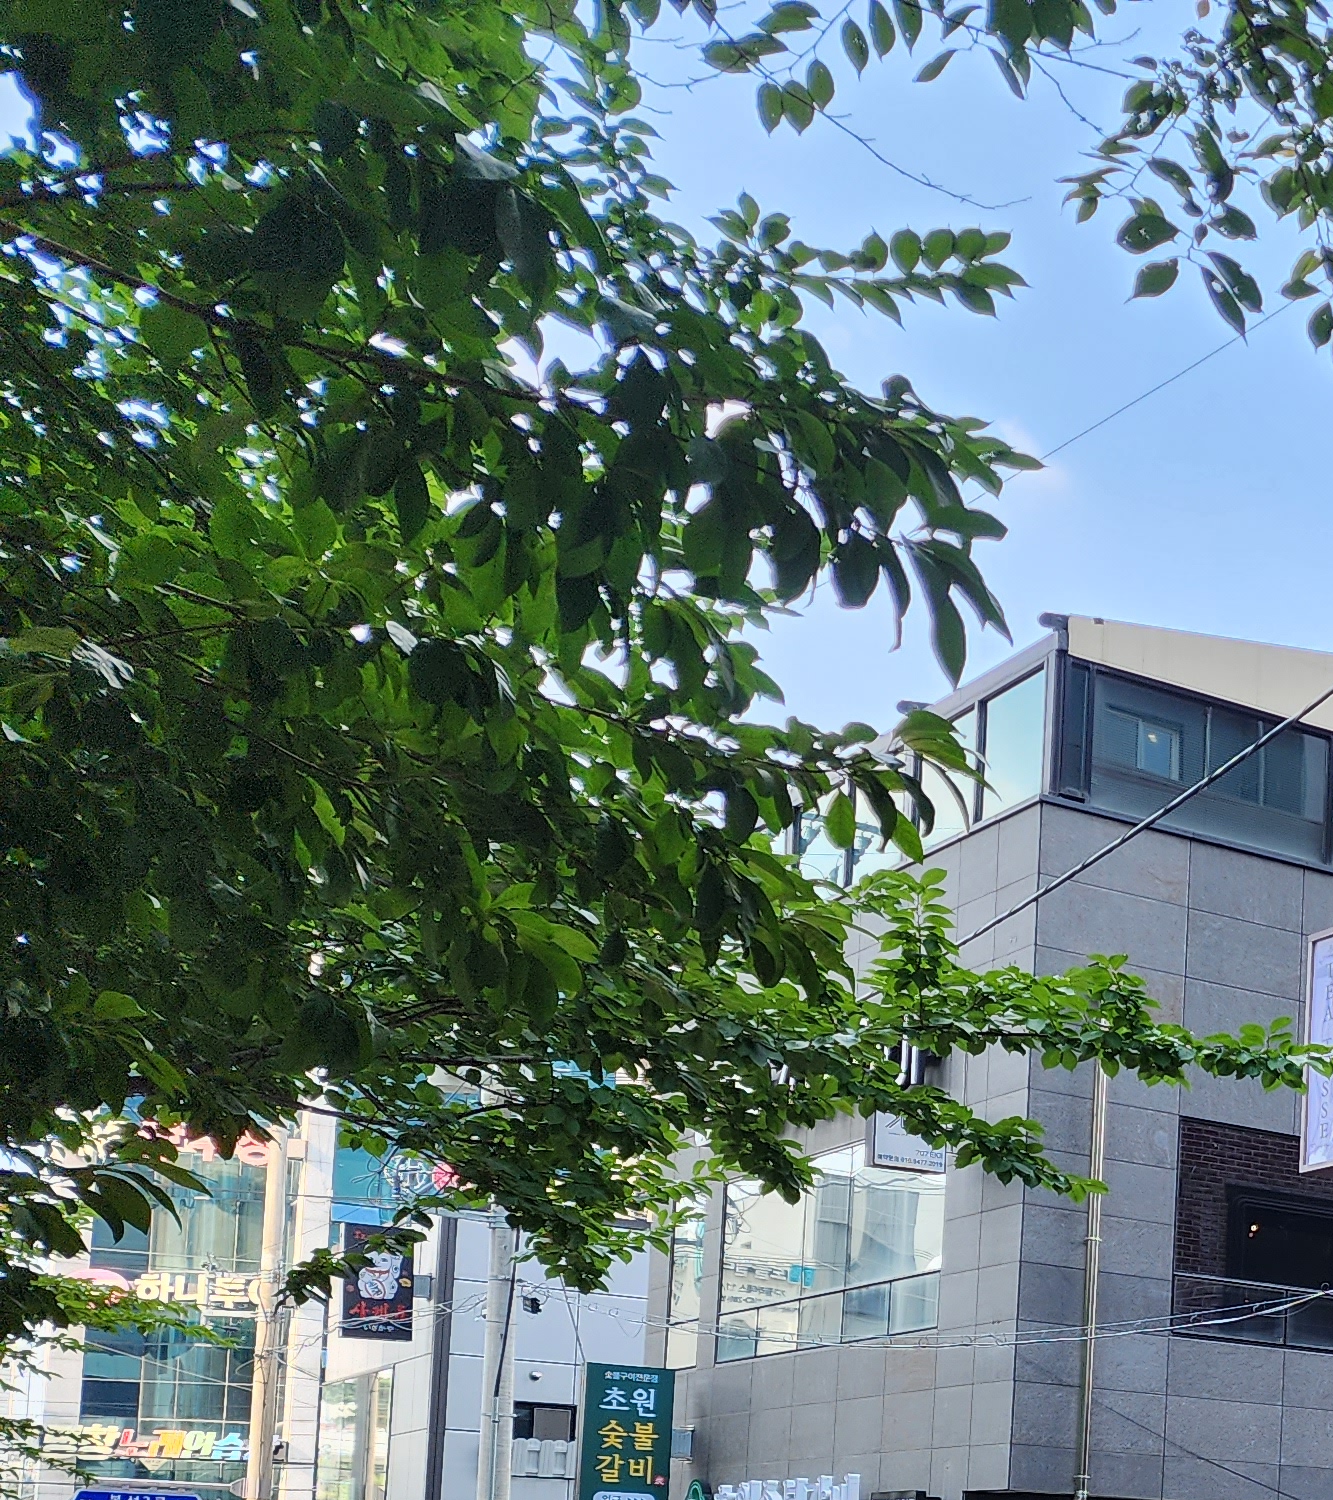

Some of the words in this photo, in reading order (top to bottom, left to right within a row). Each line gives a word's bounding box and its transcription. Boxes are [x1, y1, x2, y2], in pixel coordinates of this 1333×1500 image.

[598, 1386, 657, 1418] 초원
[597, 1419, 660, 1451] 숯불
[594, 1453, 654, 1485] 갈비
